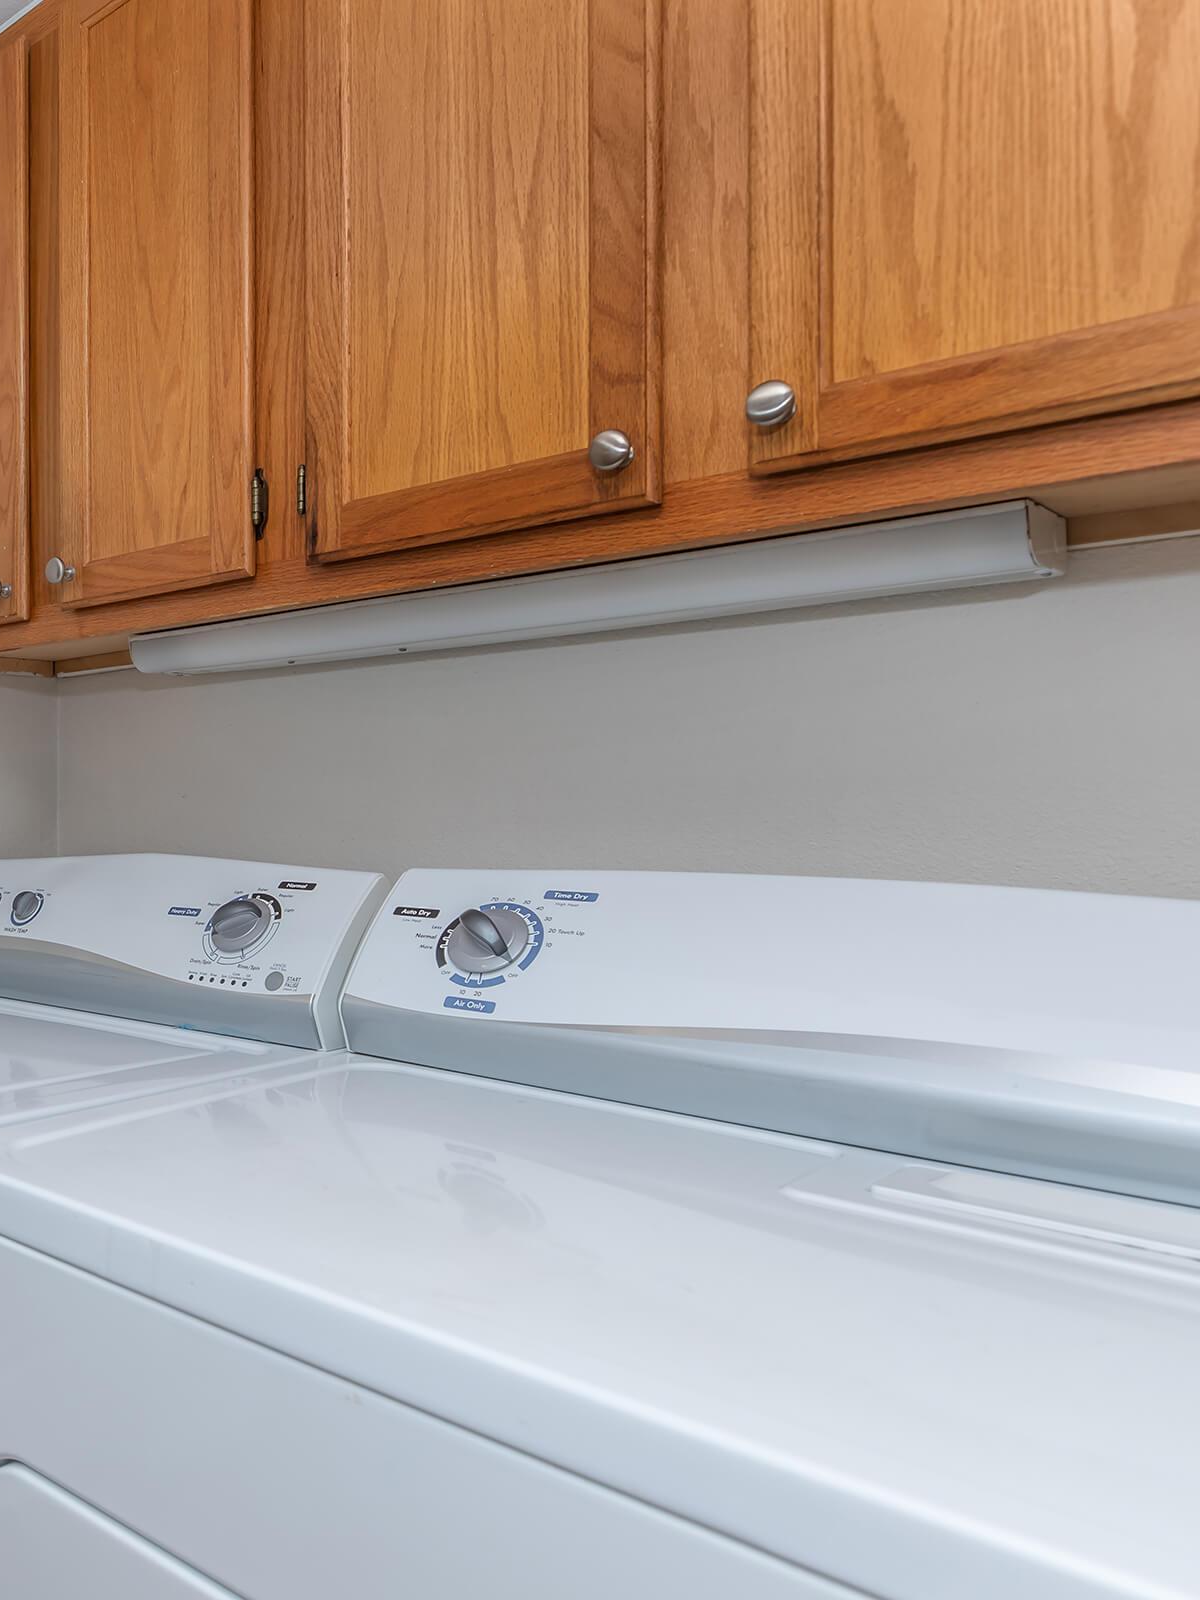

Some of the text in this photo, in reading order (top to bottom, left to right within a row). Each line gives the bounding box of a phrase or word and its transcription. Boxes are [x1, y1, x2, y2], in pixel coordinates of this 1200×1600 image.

[574, 893, 589, 901] Dry
[418, 909, 432, 917] Dry
[416, 932, 437, 940] Normal
[453, 999, 486, 1011] Air Only
